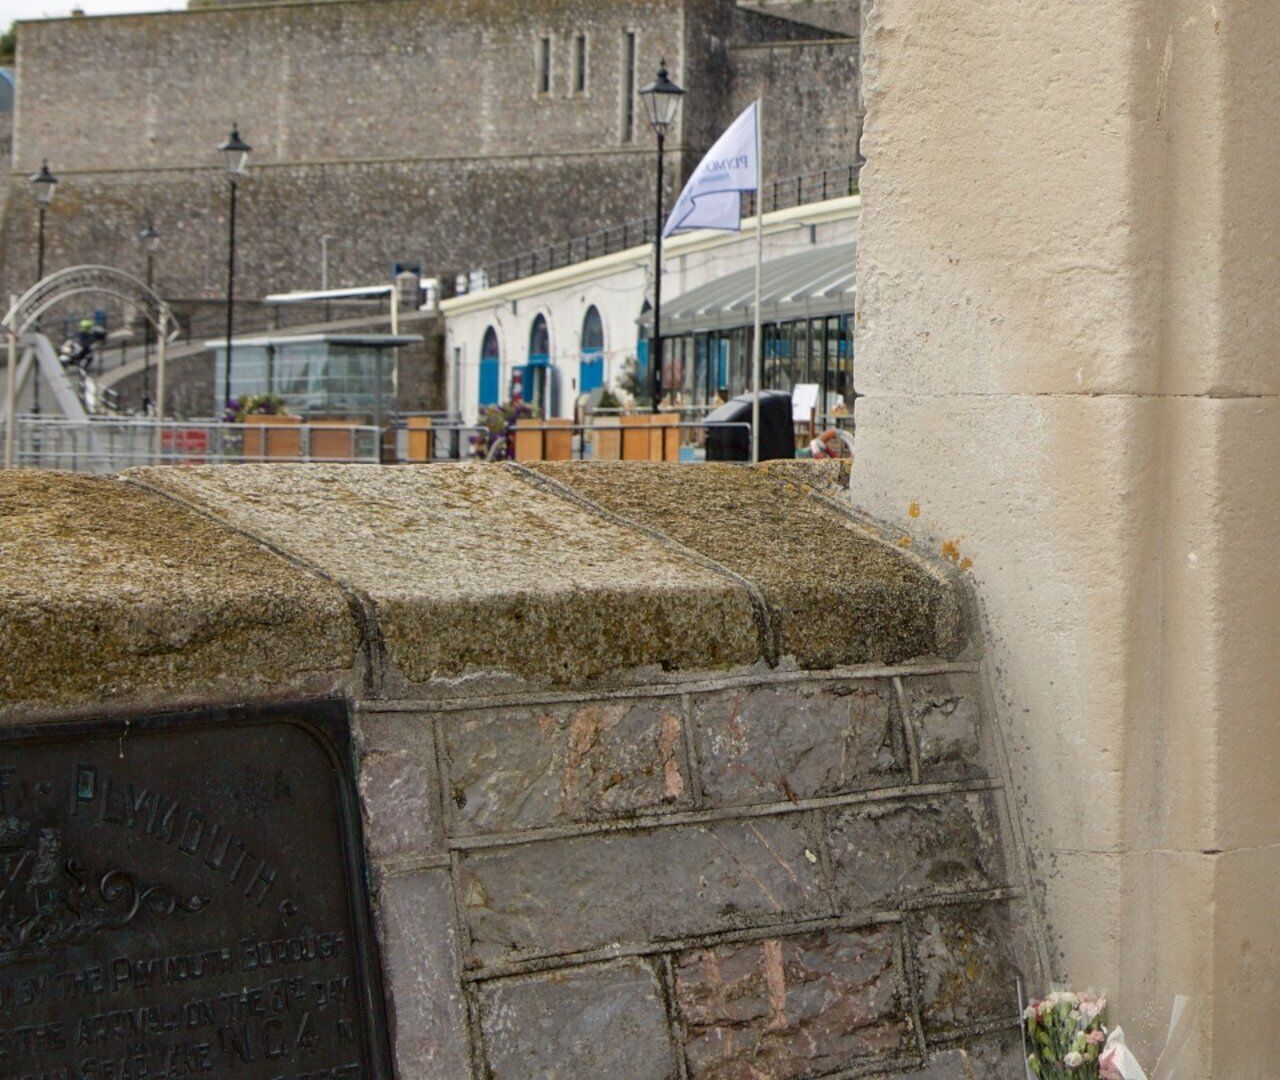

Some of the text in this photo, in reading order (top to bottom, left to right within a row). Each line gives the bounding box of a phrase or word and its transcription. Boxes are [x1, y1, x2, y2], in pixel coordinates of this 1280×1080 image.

[54, 966, 105, 1001] THE
[111, 947, 234, 993] PLYMOUTH
[240, 931, 346, 971] BOROUGH
[13, 1021, 67, 1053] THE
[183, 999, 215, 1028] ON
[218, 986, 266, 1019] THE
